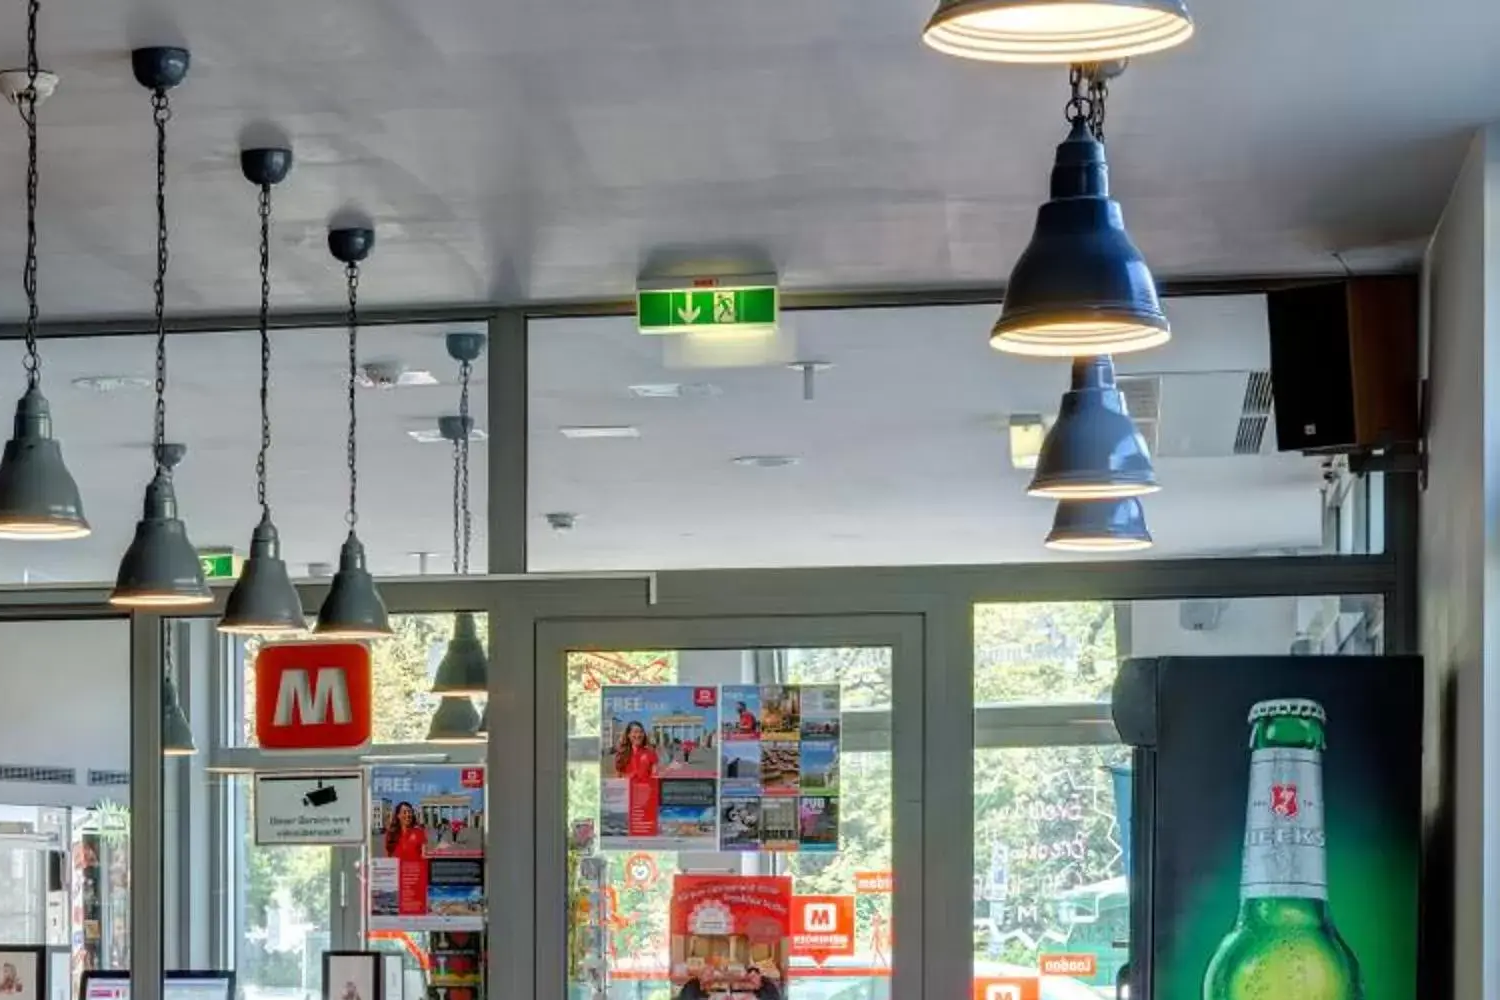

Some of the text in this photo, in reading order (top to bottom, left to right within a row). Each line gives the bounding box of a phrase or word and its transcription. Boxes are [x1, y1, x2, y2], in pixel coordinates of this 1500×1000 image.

[273, 666, 352, 726] M
[604, 695, 644, 712] FREE
[373, 776, 412, 793] FREE
